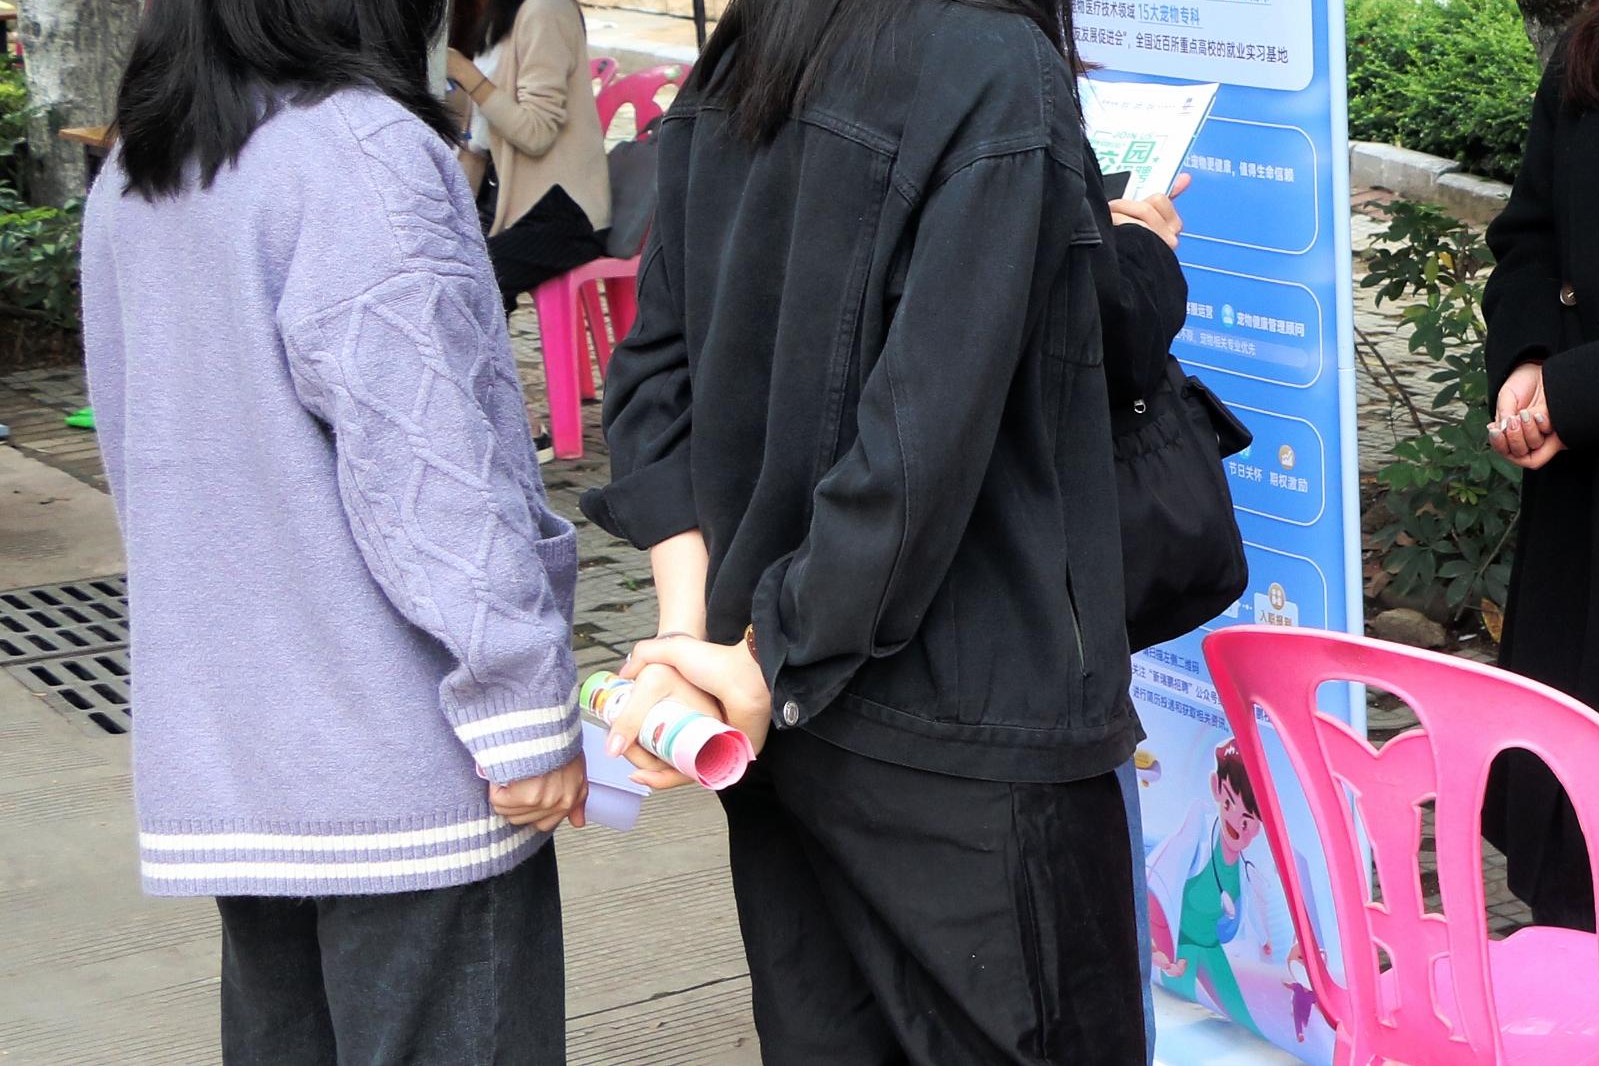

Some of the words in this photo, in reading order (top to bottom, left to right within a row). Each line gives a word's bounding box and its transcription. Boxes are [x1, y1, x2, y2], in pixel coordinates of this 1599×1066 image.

[1236, 312, 1305, 337] 宠物健康管理顾问
[1228, 461, 1263, 482] 节日关怀
[1132, 664, 1222, 705] 关注“新瑞鹏招聘”公众号
